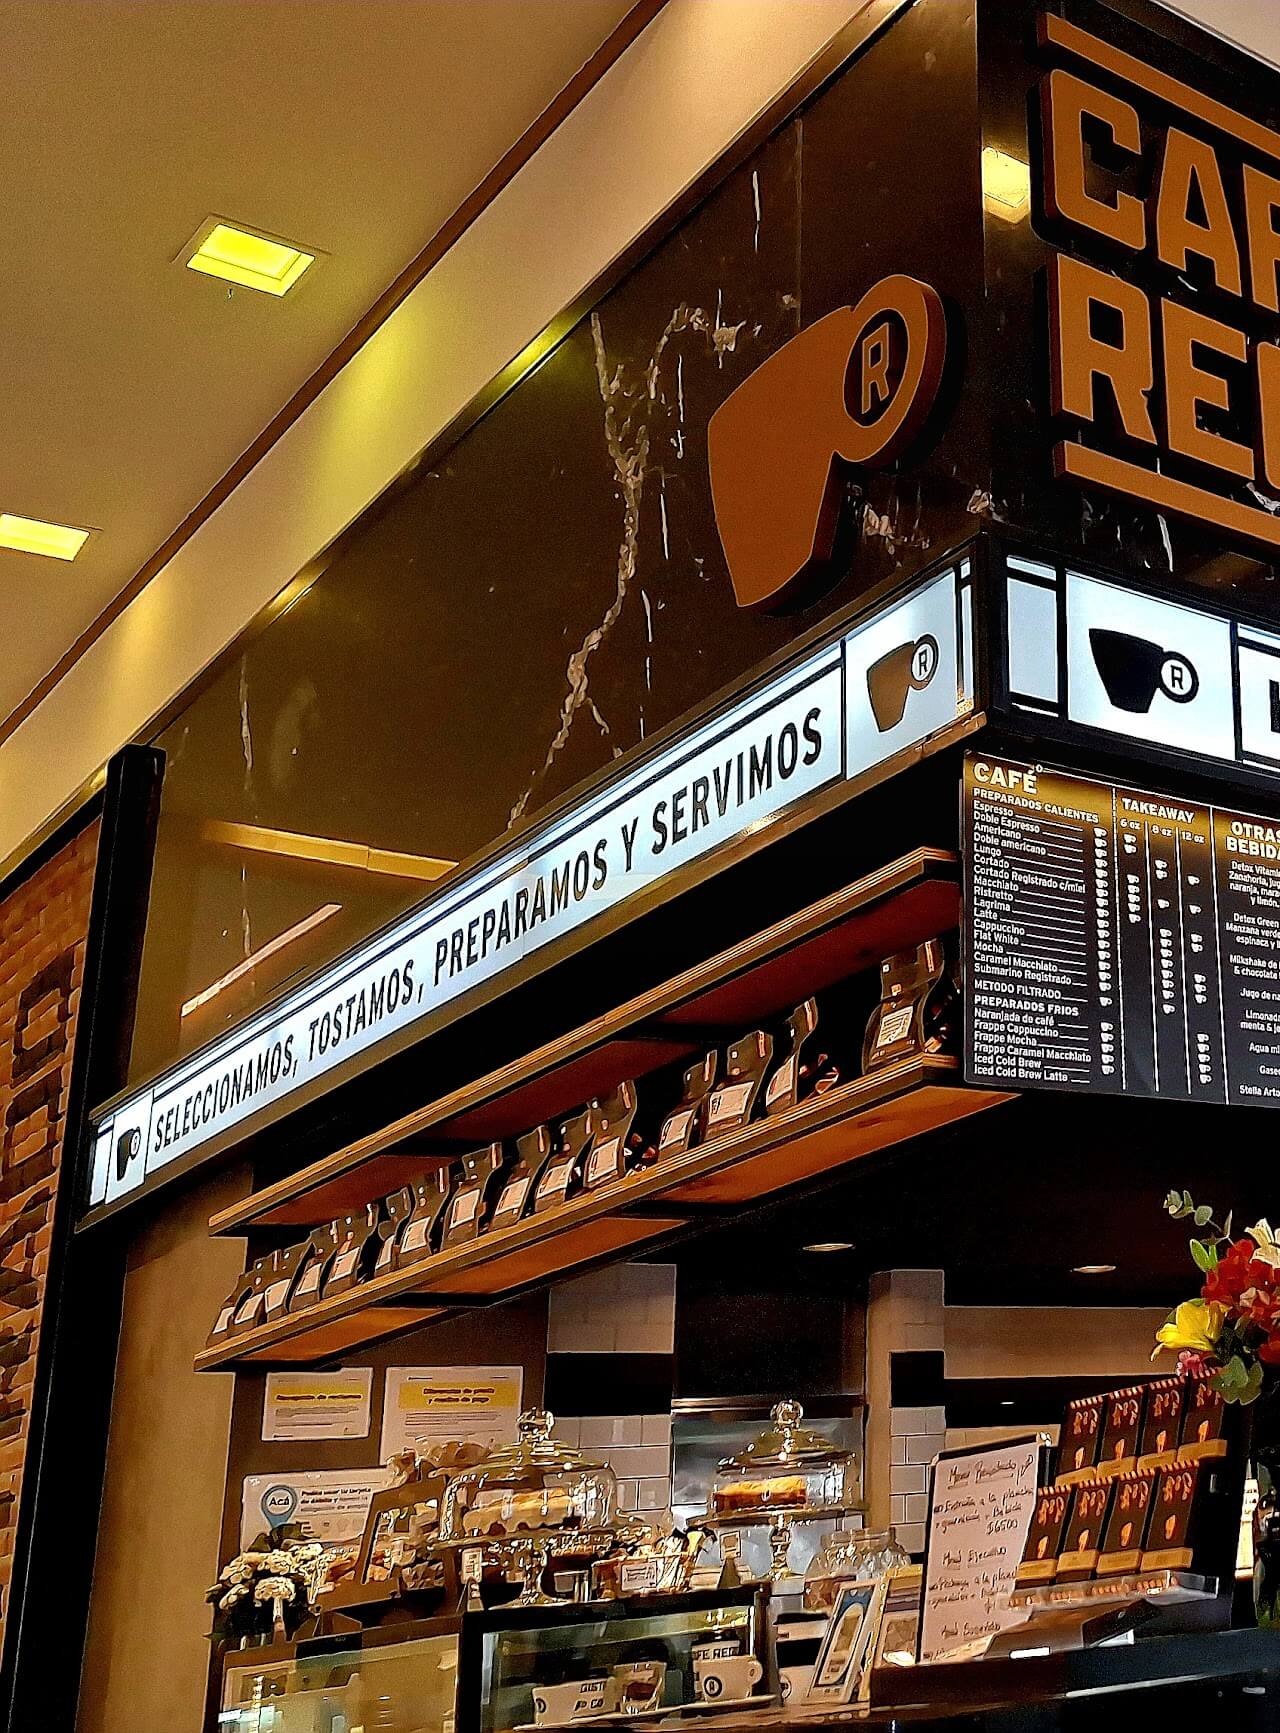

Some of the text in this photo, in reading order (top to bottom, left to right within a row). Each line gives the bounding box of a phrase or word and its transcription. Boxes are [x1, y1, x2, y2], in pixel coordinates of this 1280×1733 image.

[862, 321, 890, 415] R
[917, 649, 929, 679] R
[1171, 663, 1185, 690] R
[973, 762, 1037, 795] CAFÉ
[974, 788, 1099, 824] PREPARADOS CALIENTES
[974, 800, 1014, 817] Espresso
[1121, 798, 1195, 824] TAKEAWAY
[974, 810, 1040, 833] Doble Espresso
[1120, 818, 1140, 830] 6 oz
[974, 822, 1021, 840] Americano
[1152, 825, 1172, 837] 8 oz
[1181, 831, 1205, 844] 12 oz
[974, 832, 1046, 855] Doble americano
[974, 843, 1001, 857] Lungo
[974, 853, 1009, 868] Cortado
[1231, 860, 1253, 873] Detox
[974, 864, 1086, 894] Cortado Registrado c/miel
[974, 874, 1019, 892] Macchiato
[974, 885, 1014, 902] Ristretto
[974, 896, 1011, 912] Lagrima
[974, 907, 998, 920] Latte
[1233, 912, 1279, 928] Detox Green
[154, 705, 822, 1152] SELECCIONAMOS, TOSTAMOS, PREPARAMOS Y SERVIMOS
[974, 918, 1025, 936] Cappuccino
[1225, 922, 1260, 936] Manzana
[974, 928, 1019, 945] Flat White
[1236, 935, 1269, 948] espinaca
[974, 940, 1004, 954] Mocha
[974, 951, 1058, 973] Caramel Macchiato
[1230, 954, 1266, 968] Milkshake
[1268, 960, 1277, 969] de
[974, 962, 1072, 985] Submarino Registrado
[1233, 966, 1240, 975] &
[1241, 966, 1278, 980] chocolate
[974, 978, 1062, 1000] METODO FILTRADO
[1240, 987, 1260, 1000] Jugo
[1261, 990, 1271, 1000] de
[974, 994, 1080, 1017] PREPARADOS FRIOS
[974, 1007, 1054, 1027] Naranjada de café
[1007, 1023, 1059, 1038] Cappuccino
[1240, 1021, 1265, 1032] menta
[1266, 1022, 1273, 1032] &
[1007, 1034, 1037, 1046] Mocha
[1249, 1042, 1270, 1055] Agua
[974, 1052, 1041, 1069] Iced Cold Brew
[1007, 1045, 1044, 1058] Caramel
[1046, 1049, 1092, 1063] Macchiato
[974, 1063, 1068, 1082] Iced Cold Brew Latte
[1239, 1085, 1262, 1096] Stella
[268, 1496, 290, 1506] Acá
